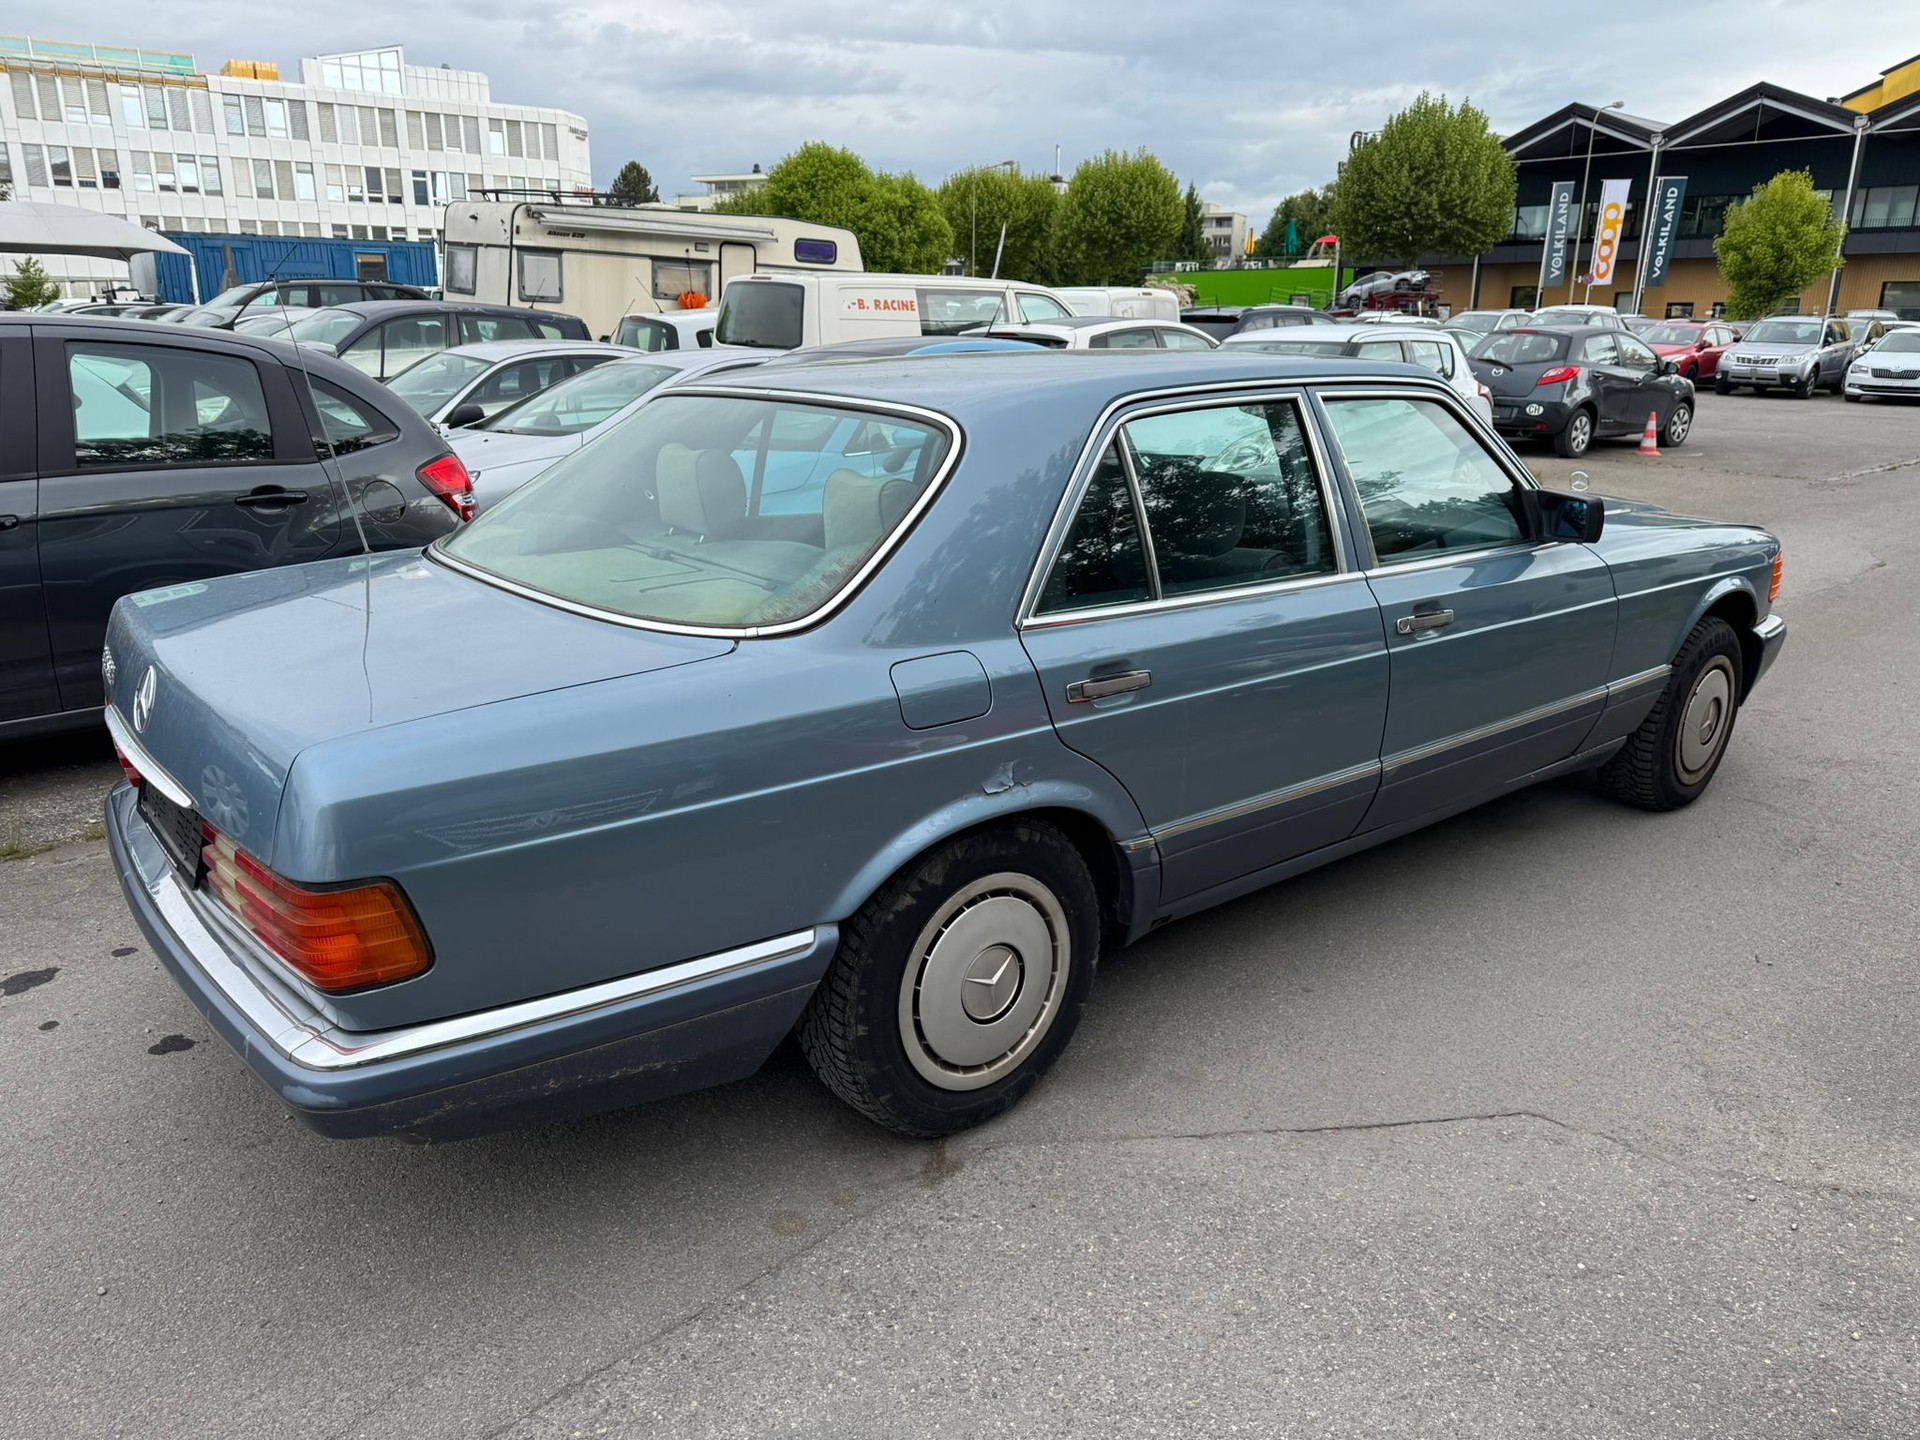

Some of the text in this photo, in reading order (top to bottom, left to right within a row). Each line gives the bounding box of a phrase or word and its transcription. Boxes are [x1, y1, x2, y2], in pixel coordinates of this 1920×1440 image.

[1550, 192, 1569, 279] VOLKILAND
[1595, 201, 1623, 280] coop
[1652, 187, 1679, 278] VOLKILAND
[873, 299, 916, 312] RACINE
[1528, 404, 1541, 415] CH
